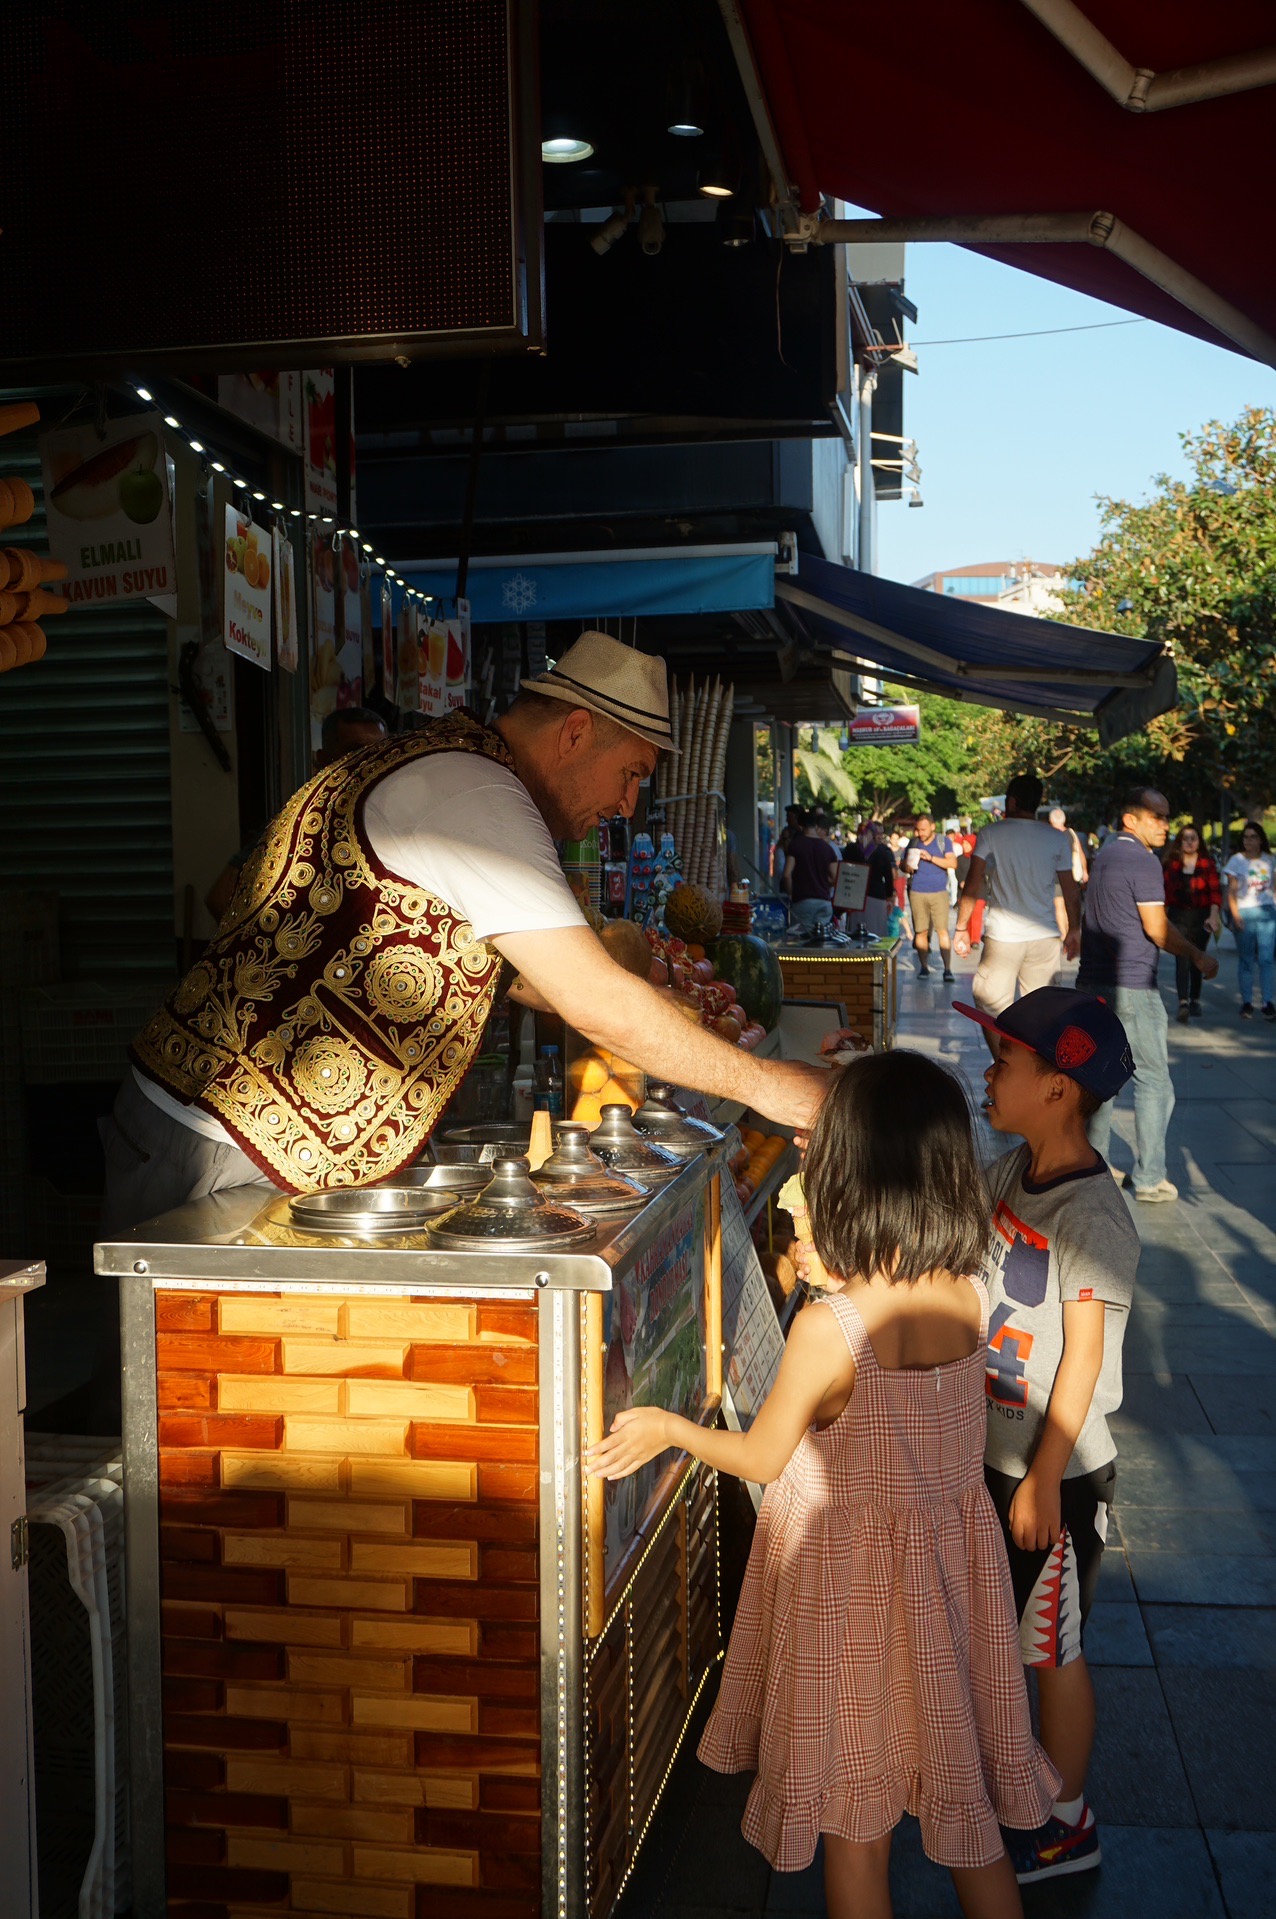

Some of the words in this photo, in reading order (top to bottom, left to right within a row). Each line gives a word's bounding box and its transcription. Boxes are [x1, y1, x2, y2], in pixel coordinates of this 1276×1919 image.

[80, 538, 142, 569] ELMALI
[62, 574, 117, 603] KAVUN
[123, 566, 168, 593] SUYU
[233, 590, 263, 624] Meyve
